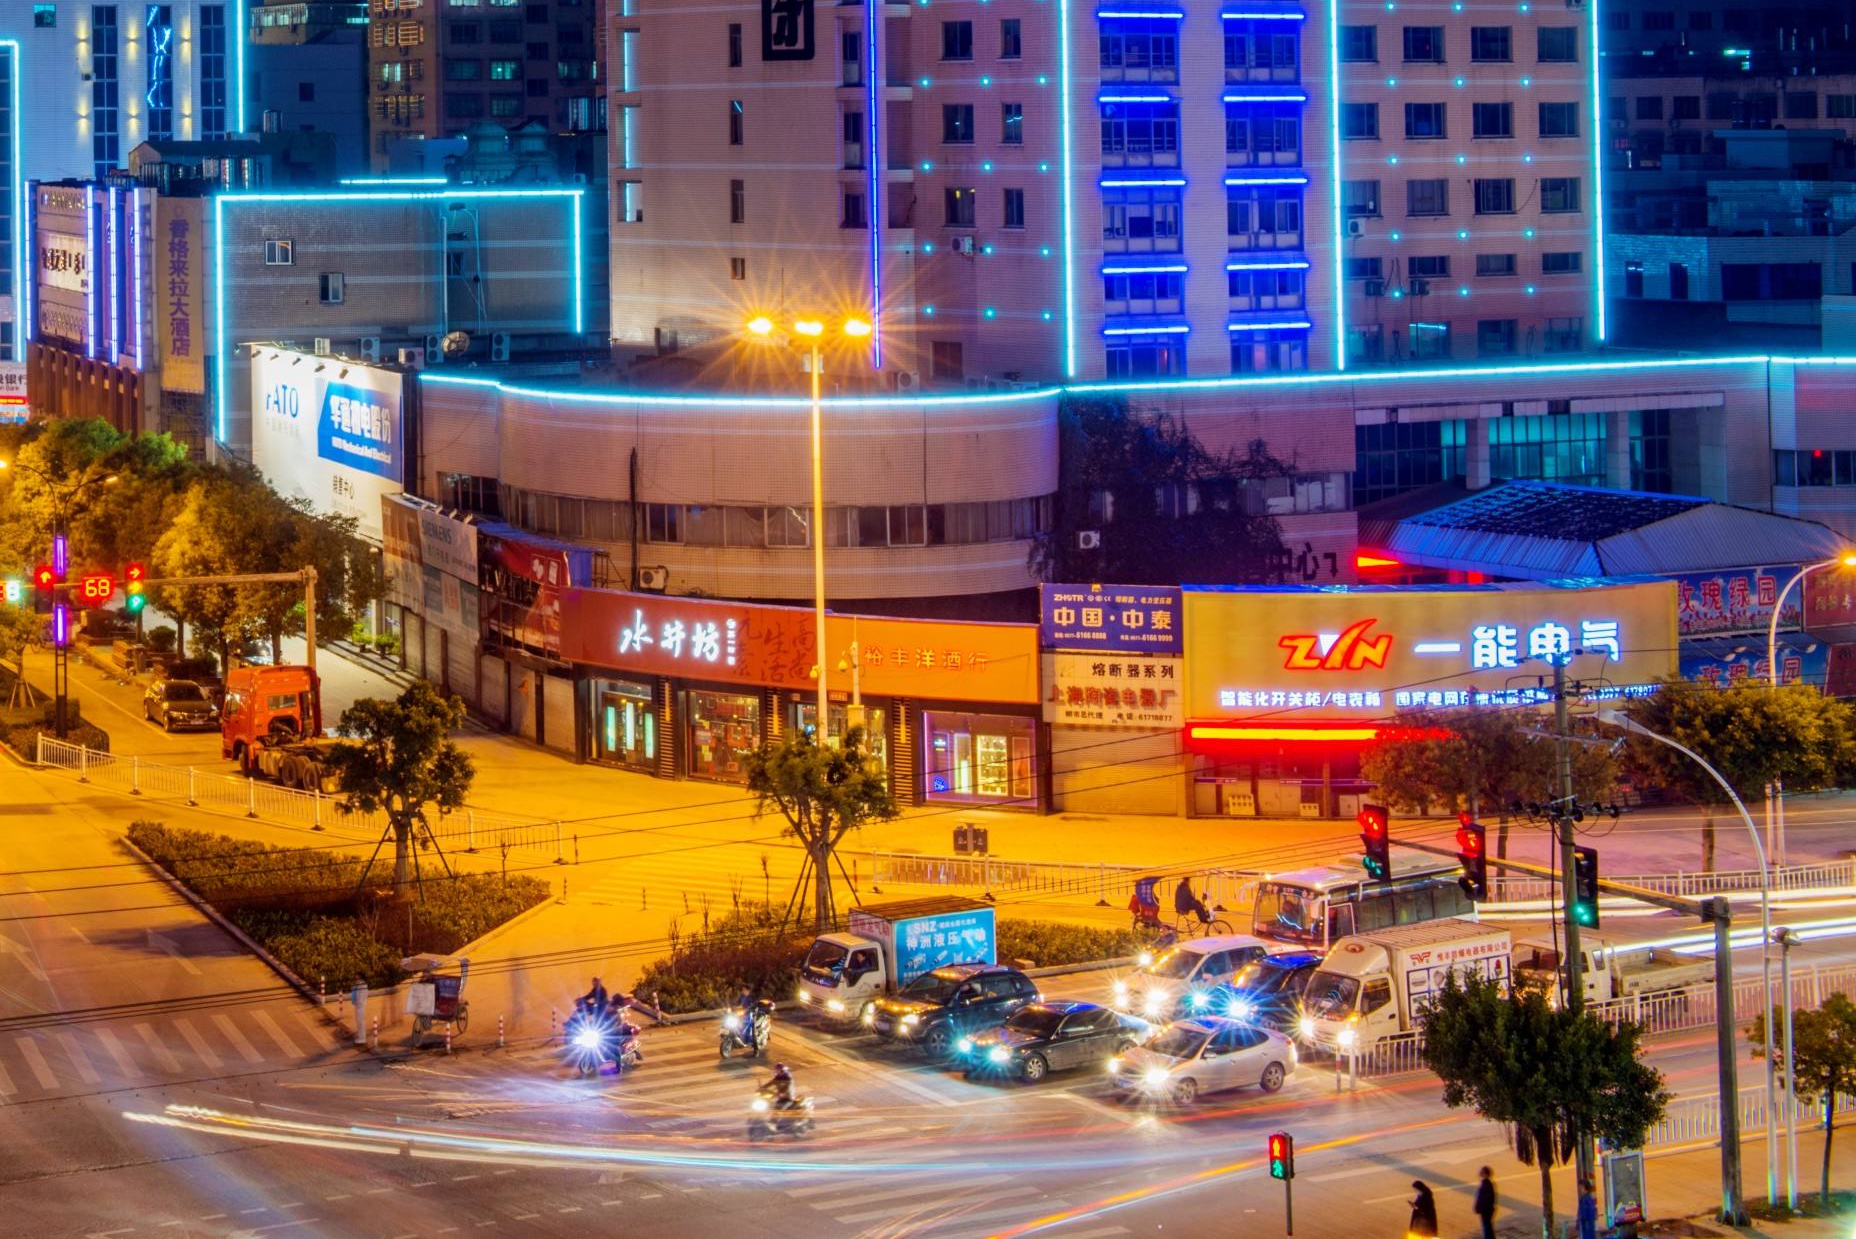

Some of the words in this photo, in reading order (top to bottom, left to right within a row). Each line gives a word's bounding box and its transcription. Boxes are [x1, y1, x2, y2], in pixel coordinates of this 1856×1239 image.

[619, 609, 721, 662] 水井坊
[1092, 662, 1174, 679] 熔断器系列
